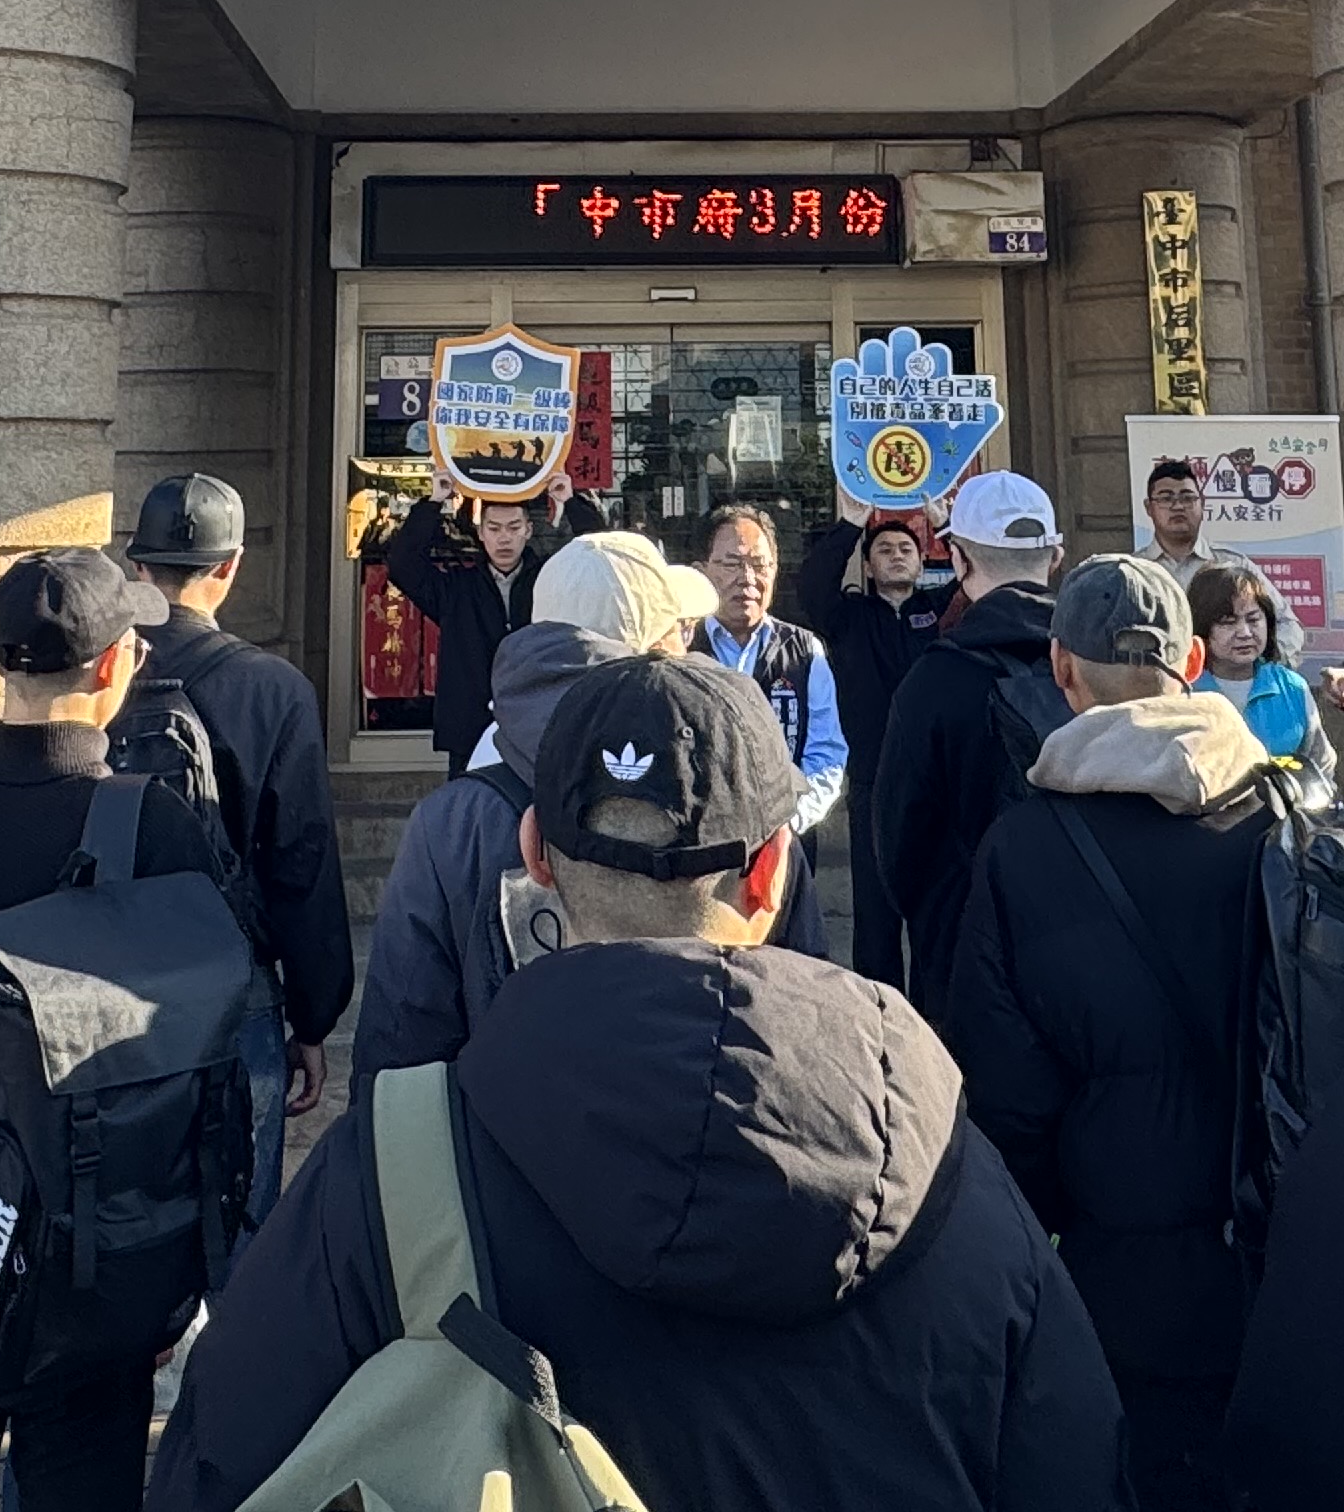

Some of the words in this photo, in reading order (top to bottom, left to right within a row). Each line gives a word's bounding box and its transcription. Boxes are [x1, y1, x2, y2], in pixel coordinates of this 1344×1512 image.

[1006, 232, 1031, 252] 84
[839, 376, 992, 396] 自己的人生自己活
[434, 407, 570, 433] 你我安全有保障
[1268, 436, 1328, 455] 交通安全月
